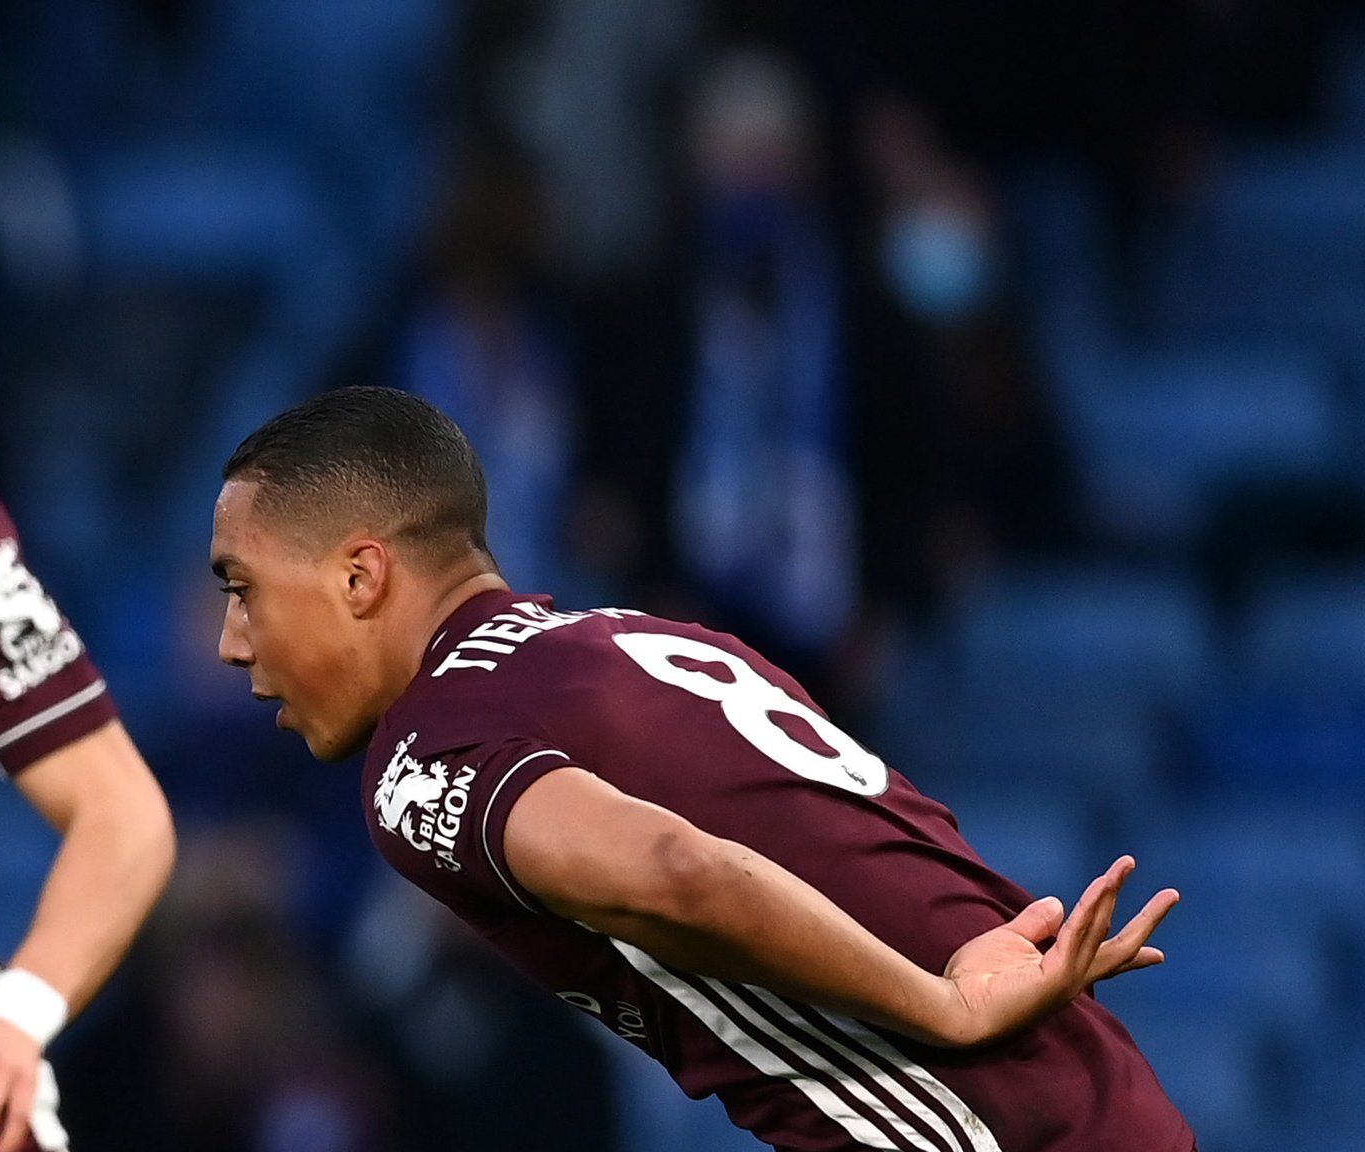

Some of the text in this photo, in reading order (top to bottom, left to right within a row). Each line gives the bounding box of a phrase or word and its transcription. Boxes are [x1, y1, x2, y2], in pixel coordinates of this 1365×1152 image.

[612, 632, 890, 798] 8
[419, 801, 440, 841] BIA
[617, 1000, 646, 1039] YOU
